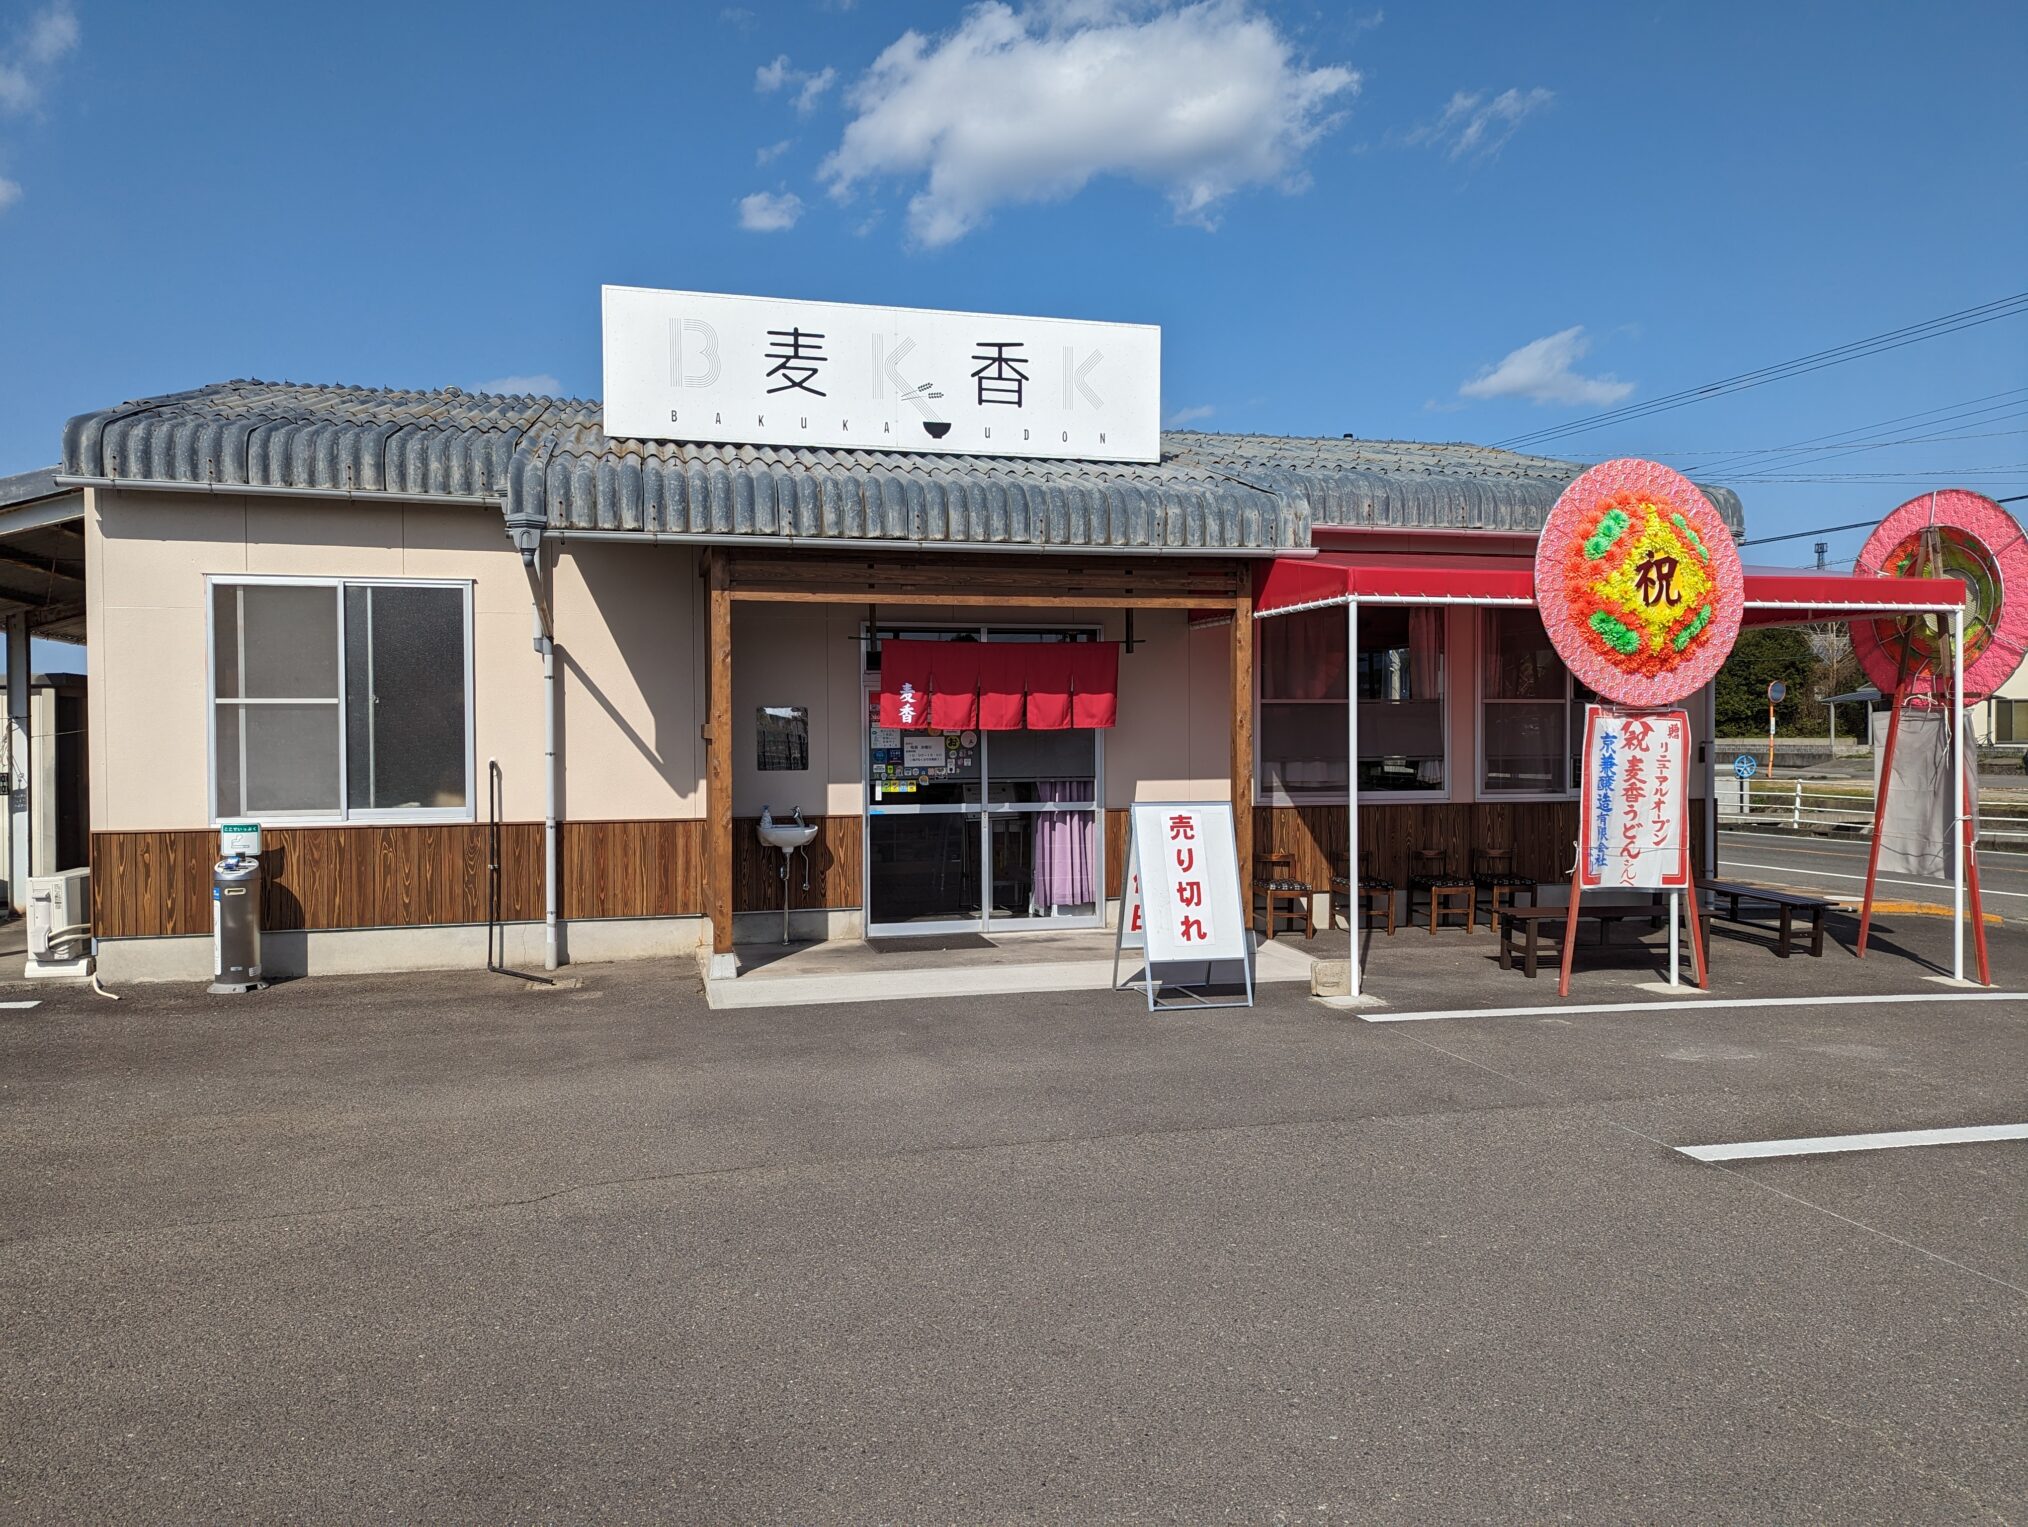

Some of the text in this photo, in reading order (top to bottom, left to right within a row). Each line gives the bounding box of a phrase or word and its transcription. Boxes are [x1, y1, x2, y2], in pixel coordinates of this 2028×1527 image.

[984, 427, 1106, 443] UDON
[1634, 549, 1682, 608] 祝
[899, 682, 917, 724] 麦香
[1650, 741, 1671, 847] リニューアルオープン
[1169, 814, 1207, 942] 売り切れ
